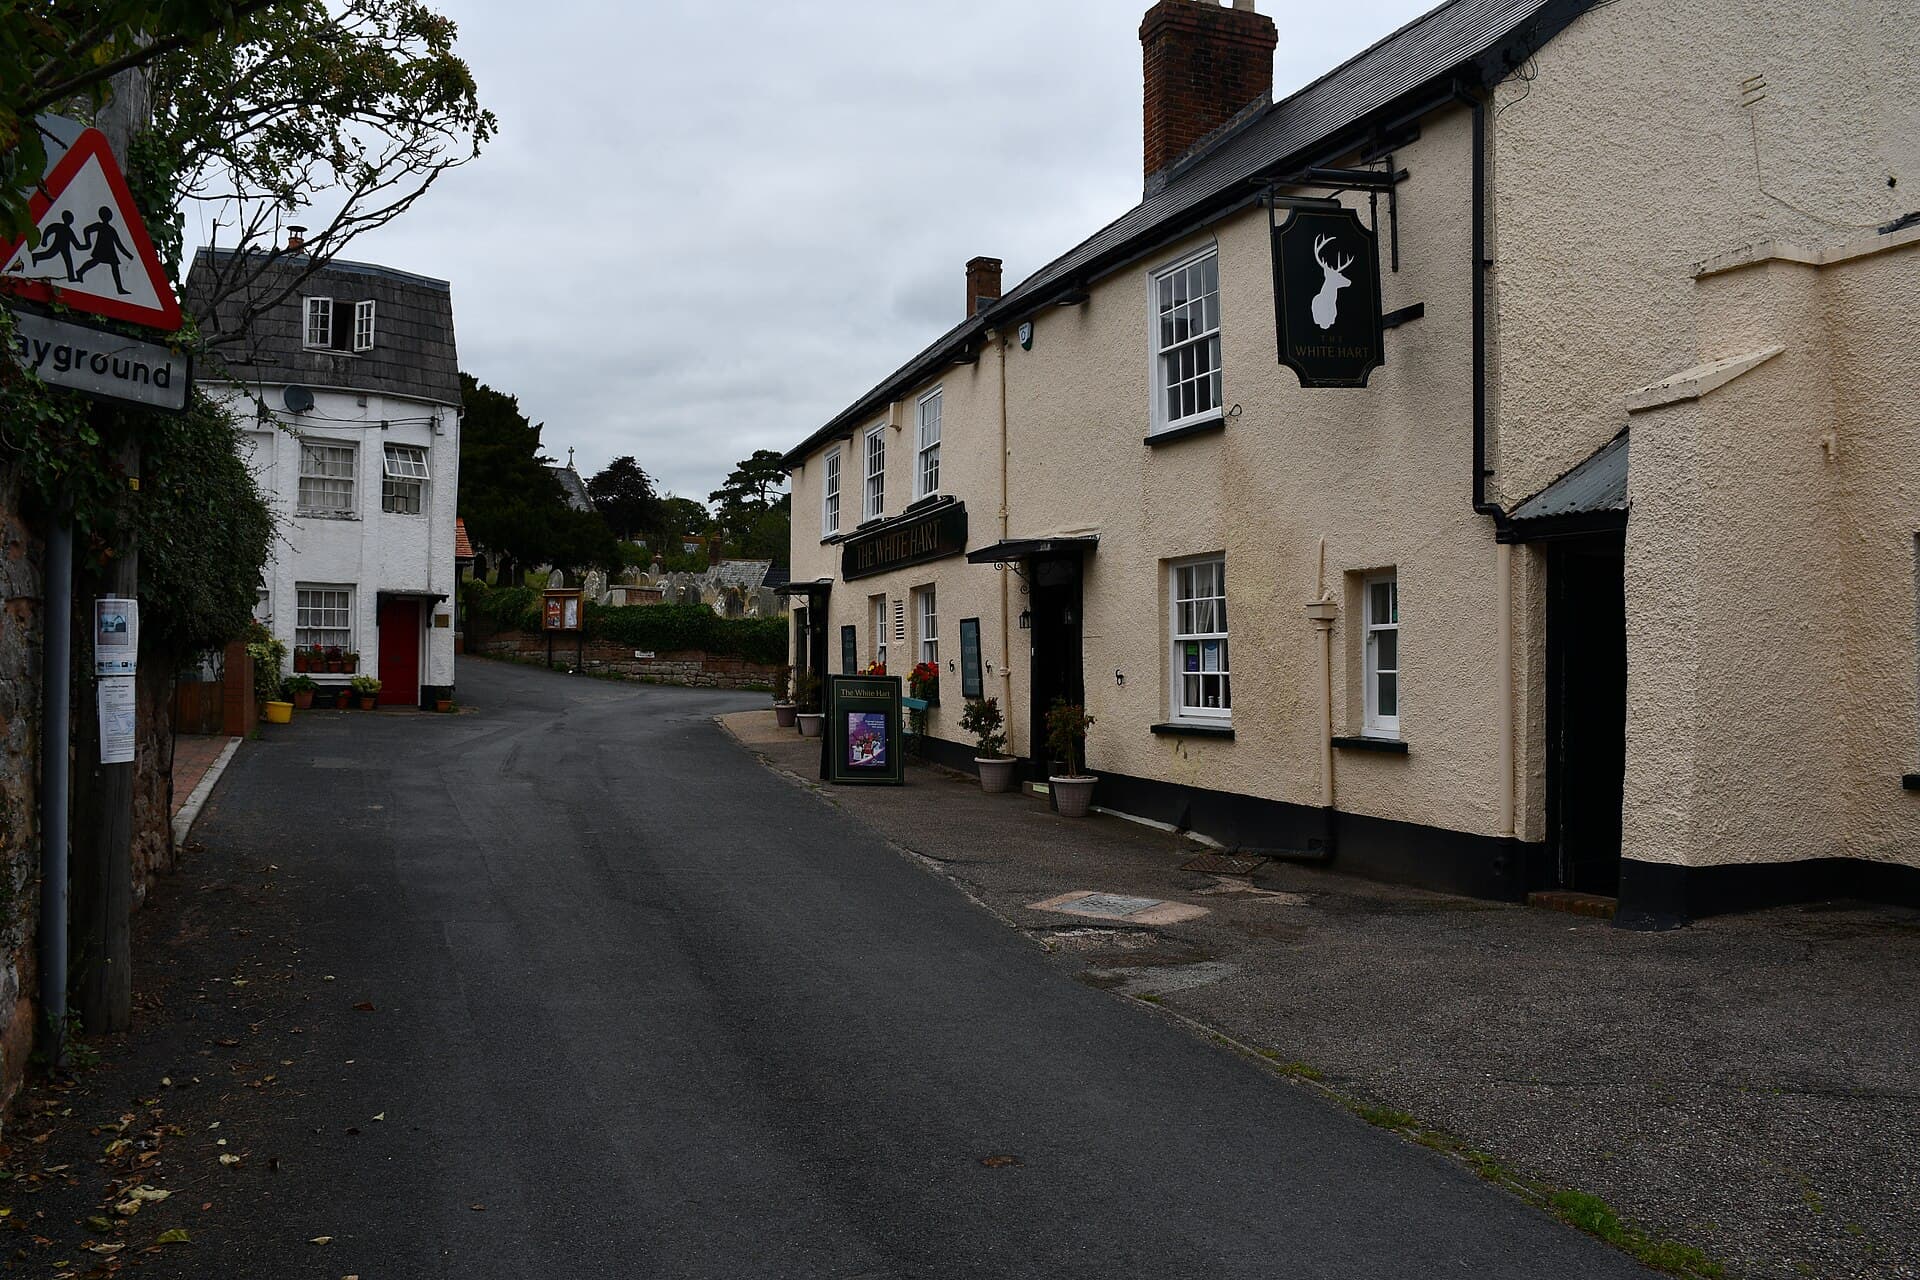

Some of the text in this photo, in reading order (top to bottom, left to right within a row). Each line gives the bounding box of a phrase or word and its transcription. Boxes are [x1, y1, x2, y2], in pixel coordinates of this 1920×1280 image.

[1295, 345, 1369, 358] WHITE HART
[857, 519, 942, 570] THE WHITE HART
[840, 688, 854, 697] The
[855, 688, 875, 697] White
